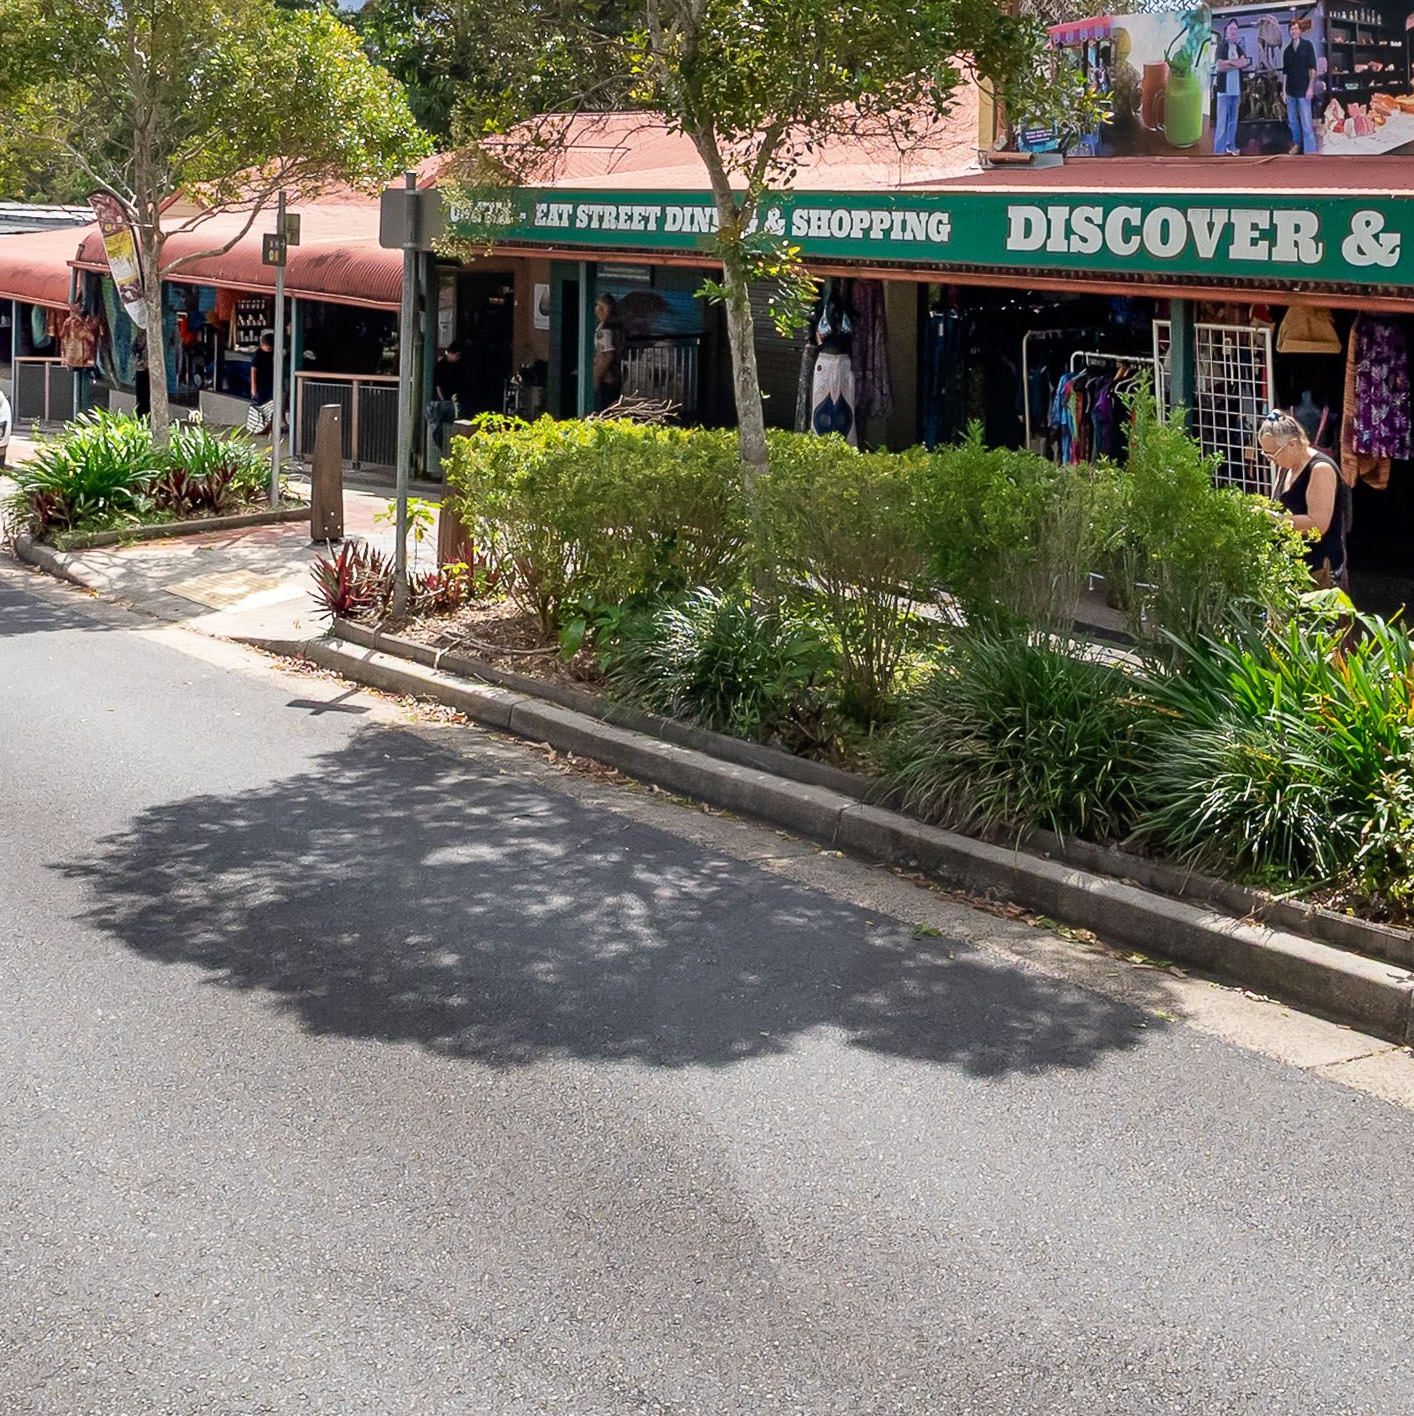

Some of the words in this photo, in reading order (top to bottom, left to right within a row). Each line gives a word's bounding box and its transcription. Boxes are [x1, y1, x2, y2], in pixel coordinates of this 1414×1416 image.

[534, 202, 573, 227] EAT
[575, 203, 661, 231] STREET
[664, 205, 758, 236] DINI
[763, 207, 786, 236] &
[792, 208, 951, 242] SHOPPING
[1006, 205, 1323, 264] DISCOVER
[1341, 210, 1401, 267] &
